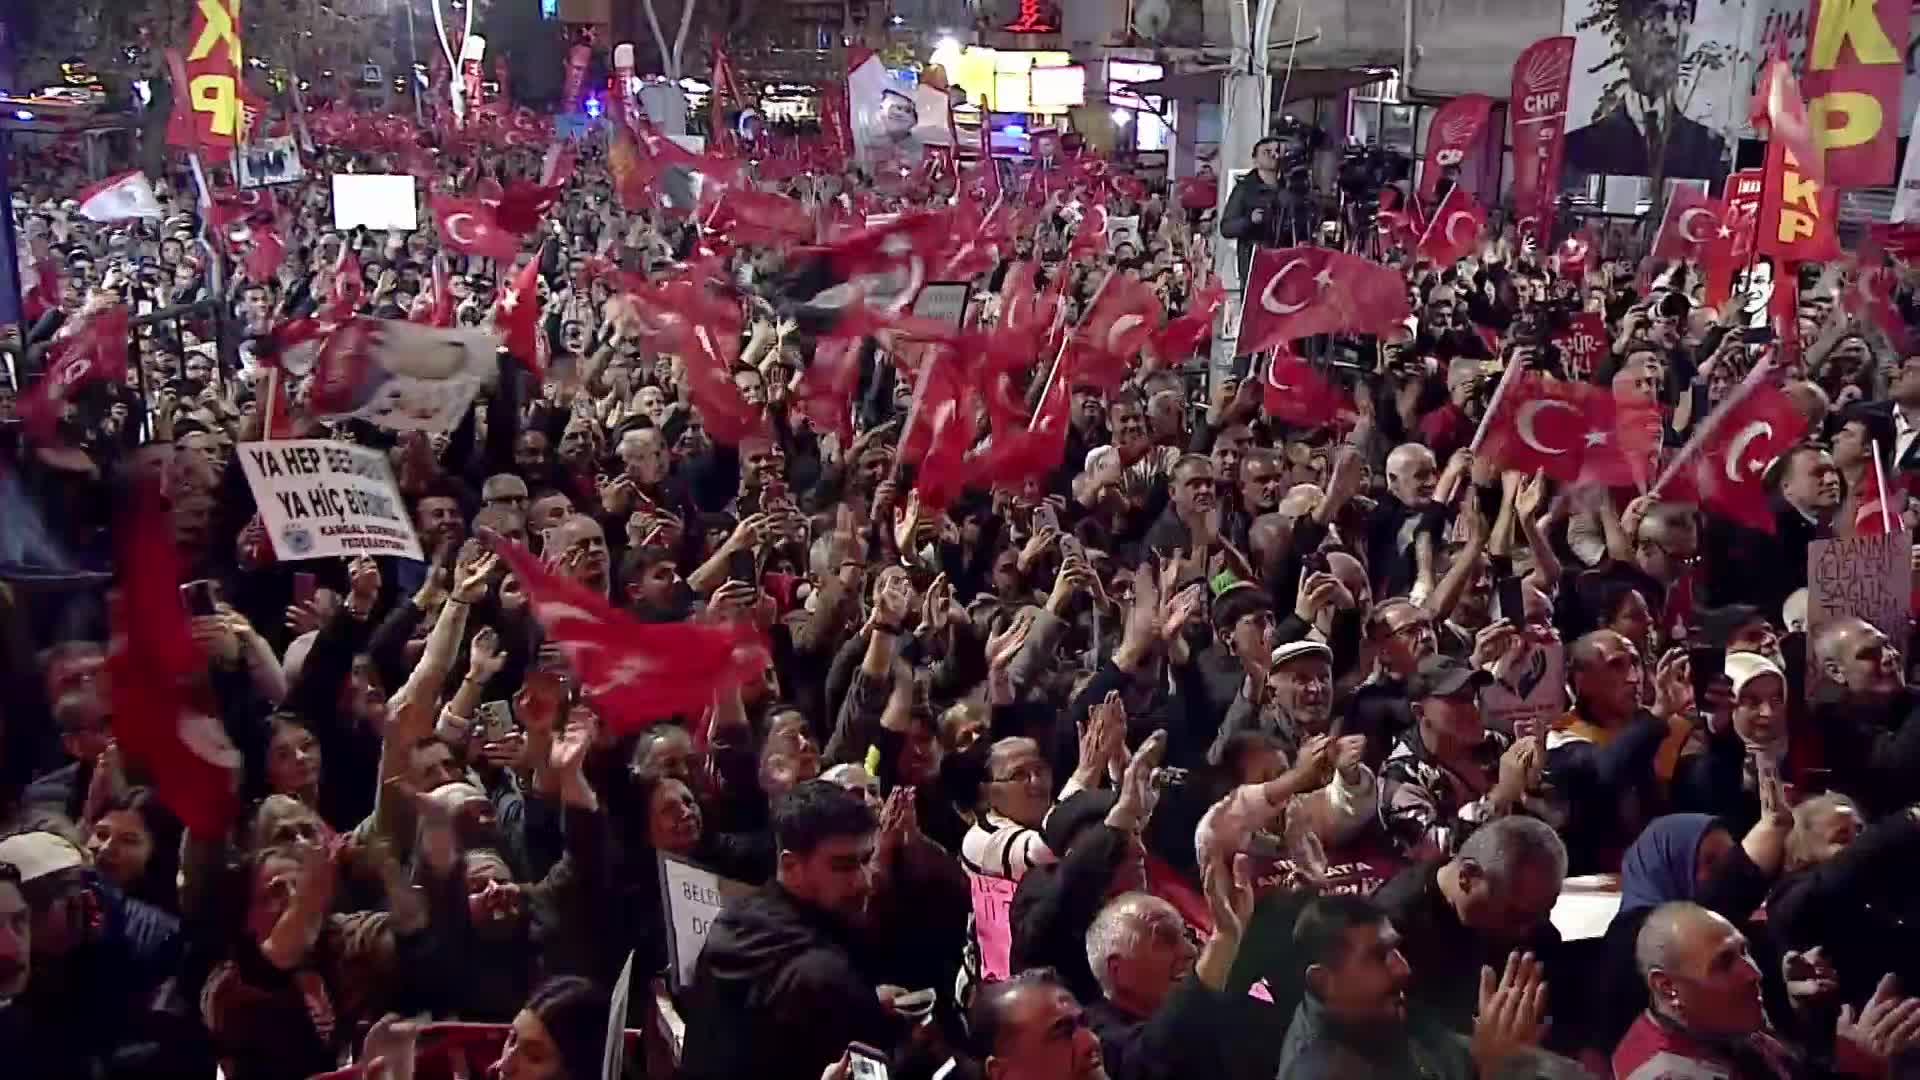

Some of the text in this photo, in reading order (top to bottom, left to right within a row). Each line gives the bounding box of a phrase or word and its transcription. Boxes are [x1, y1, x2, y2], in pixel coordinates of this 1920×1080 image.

[1524, 92, 1559, 113] CHP
[250, 450, 283, 477] YA
[282, 447, 321, 475] HEP
[276, 491, 310, 520] YA
[308, 481, 346, 523] HİÇ
